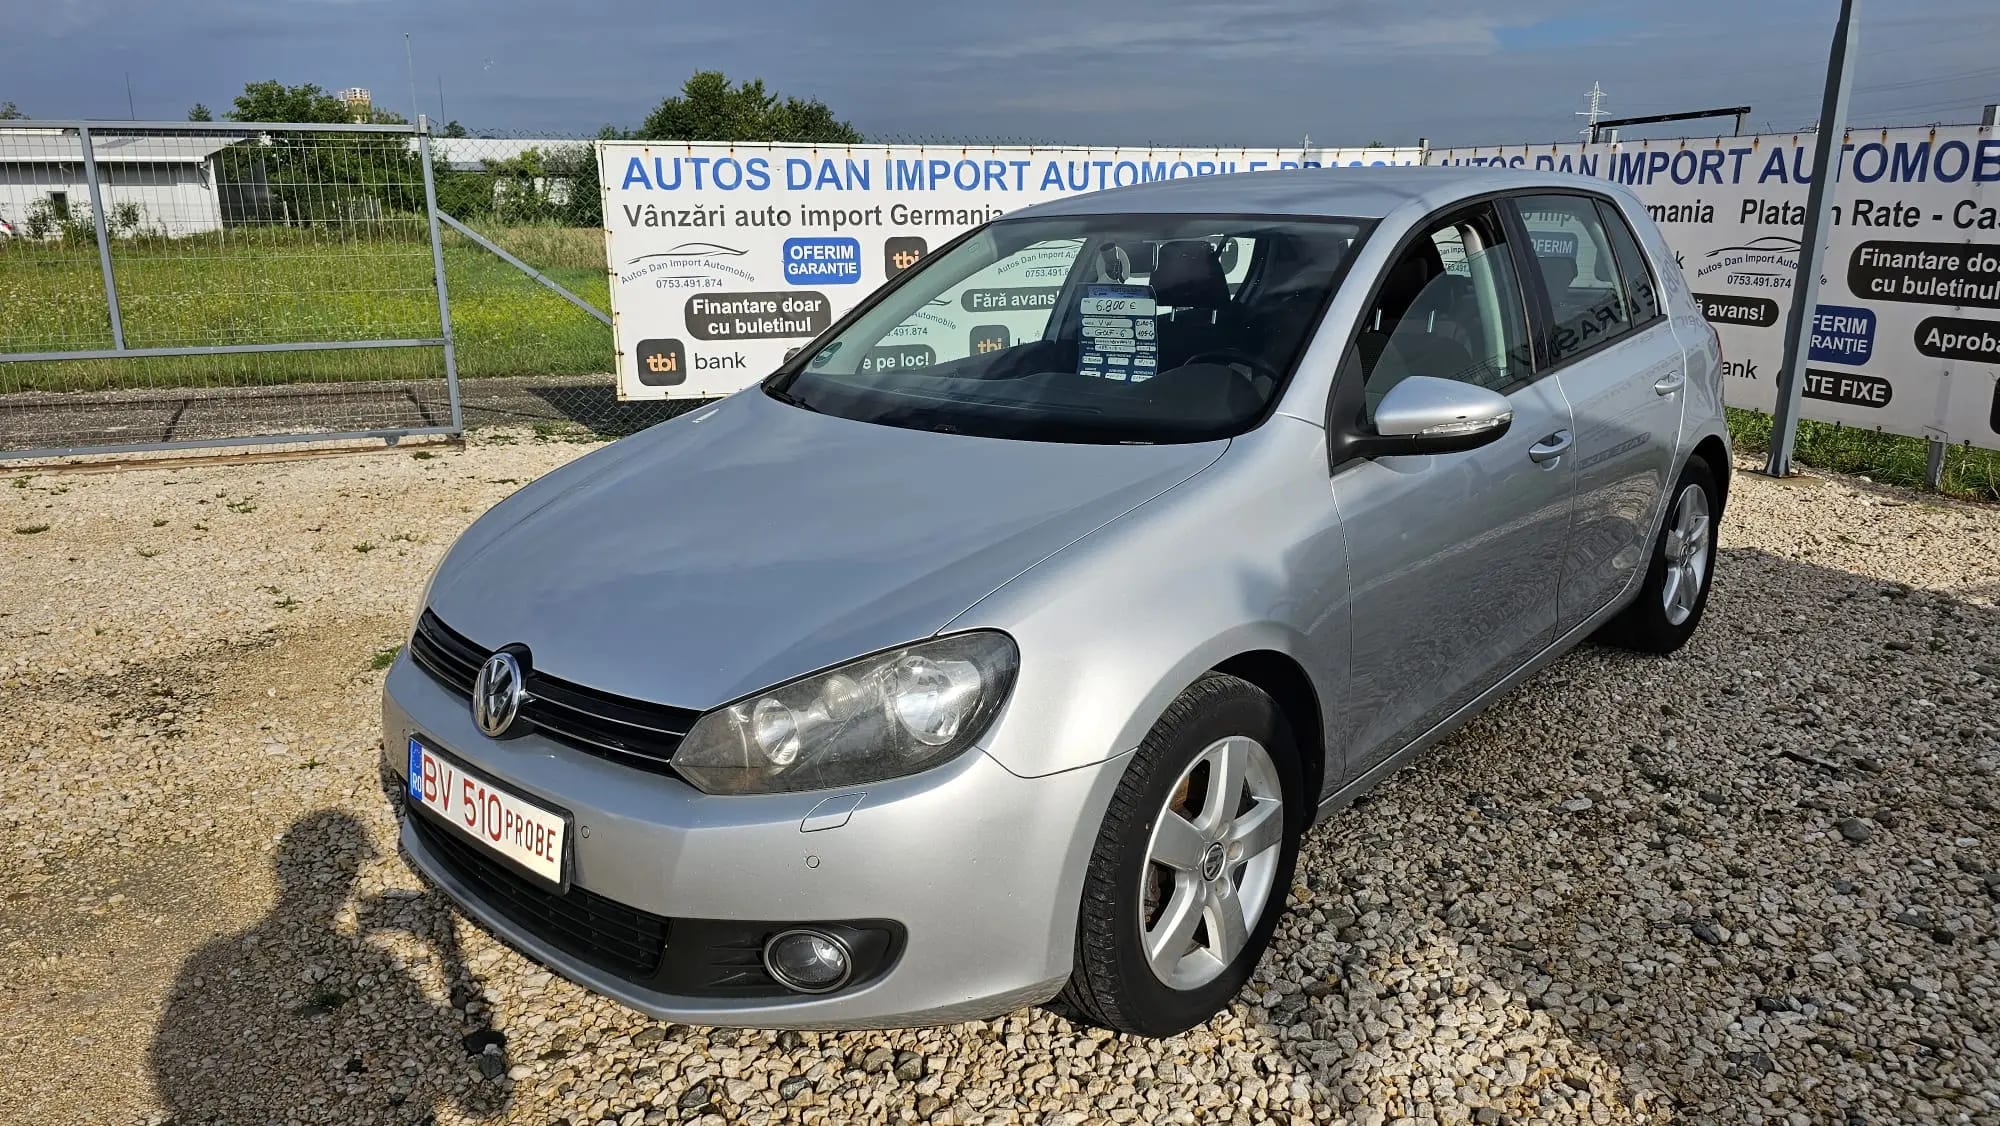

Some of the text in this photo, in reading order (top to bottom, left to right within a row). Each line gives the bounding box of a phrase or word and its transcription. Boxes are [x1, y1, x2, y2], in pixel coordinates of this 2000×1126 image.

[621, 156, 771, 191] AUTOS
[786, 158, 871, 191] DAN
[885, 159, 1031, 191] IMPORT
[1608, 147, 1753, 185] IMPORT
[622, 203, 726, 227] Vânzări
[735, 206, 792, 227] auto
[801, 202, 883, 231] import
[1645, 199, 1714, 224] mania
[1851, 199, 1921, 228] Rate
[1953, 199, 2000, 229] Ca
[790, 245, 854, 260] OFERIM
[1021, 255, 1036, 264] Dan
[1038, 251, 1064, 260] Import
[1859, 247, 2000, 273] Finantare do
[621, 259, 755, 285] Autos Dan Import Automobile
[1697, 261, 1722, 277] Autos
[1725, 256, 1743, 267] Dan
[1745, 254, 1775, 264] Import
[656, 278, 722, 289] 0753.491.874
[1727, 274, 1792, 289] 0753.491.874
[1870, 275, 2000, 300] cu buletinul
[692, 297, 822, 315] Finantare doar
[973, 292, 1007, 308] Fără
[1096, 299, 1126, 312] 6.800
[1707, 304, 1765, 321] avans!
[707, 316, 812, 335] cu buletinul
[646, 351, 747, 372] tbi bank
[876, 356, 896, 373] pe
[900, 351, 929, 367] loc!
[1722, 358, 1758, 380] ank
[1839, 379, 1887, 402] FIXE
[412, 771, 423, 793] RO
[423, 753, 557, 864] BV 510 PROBE
